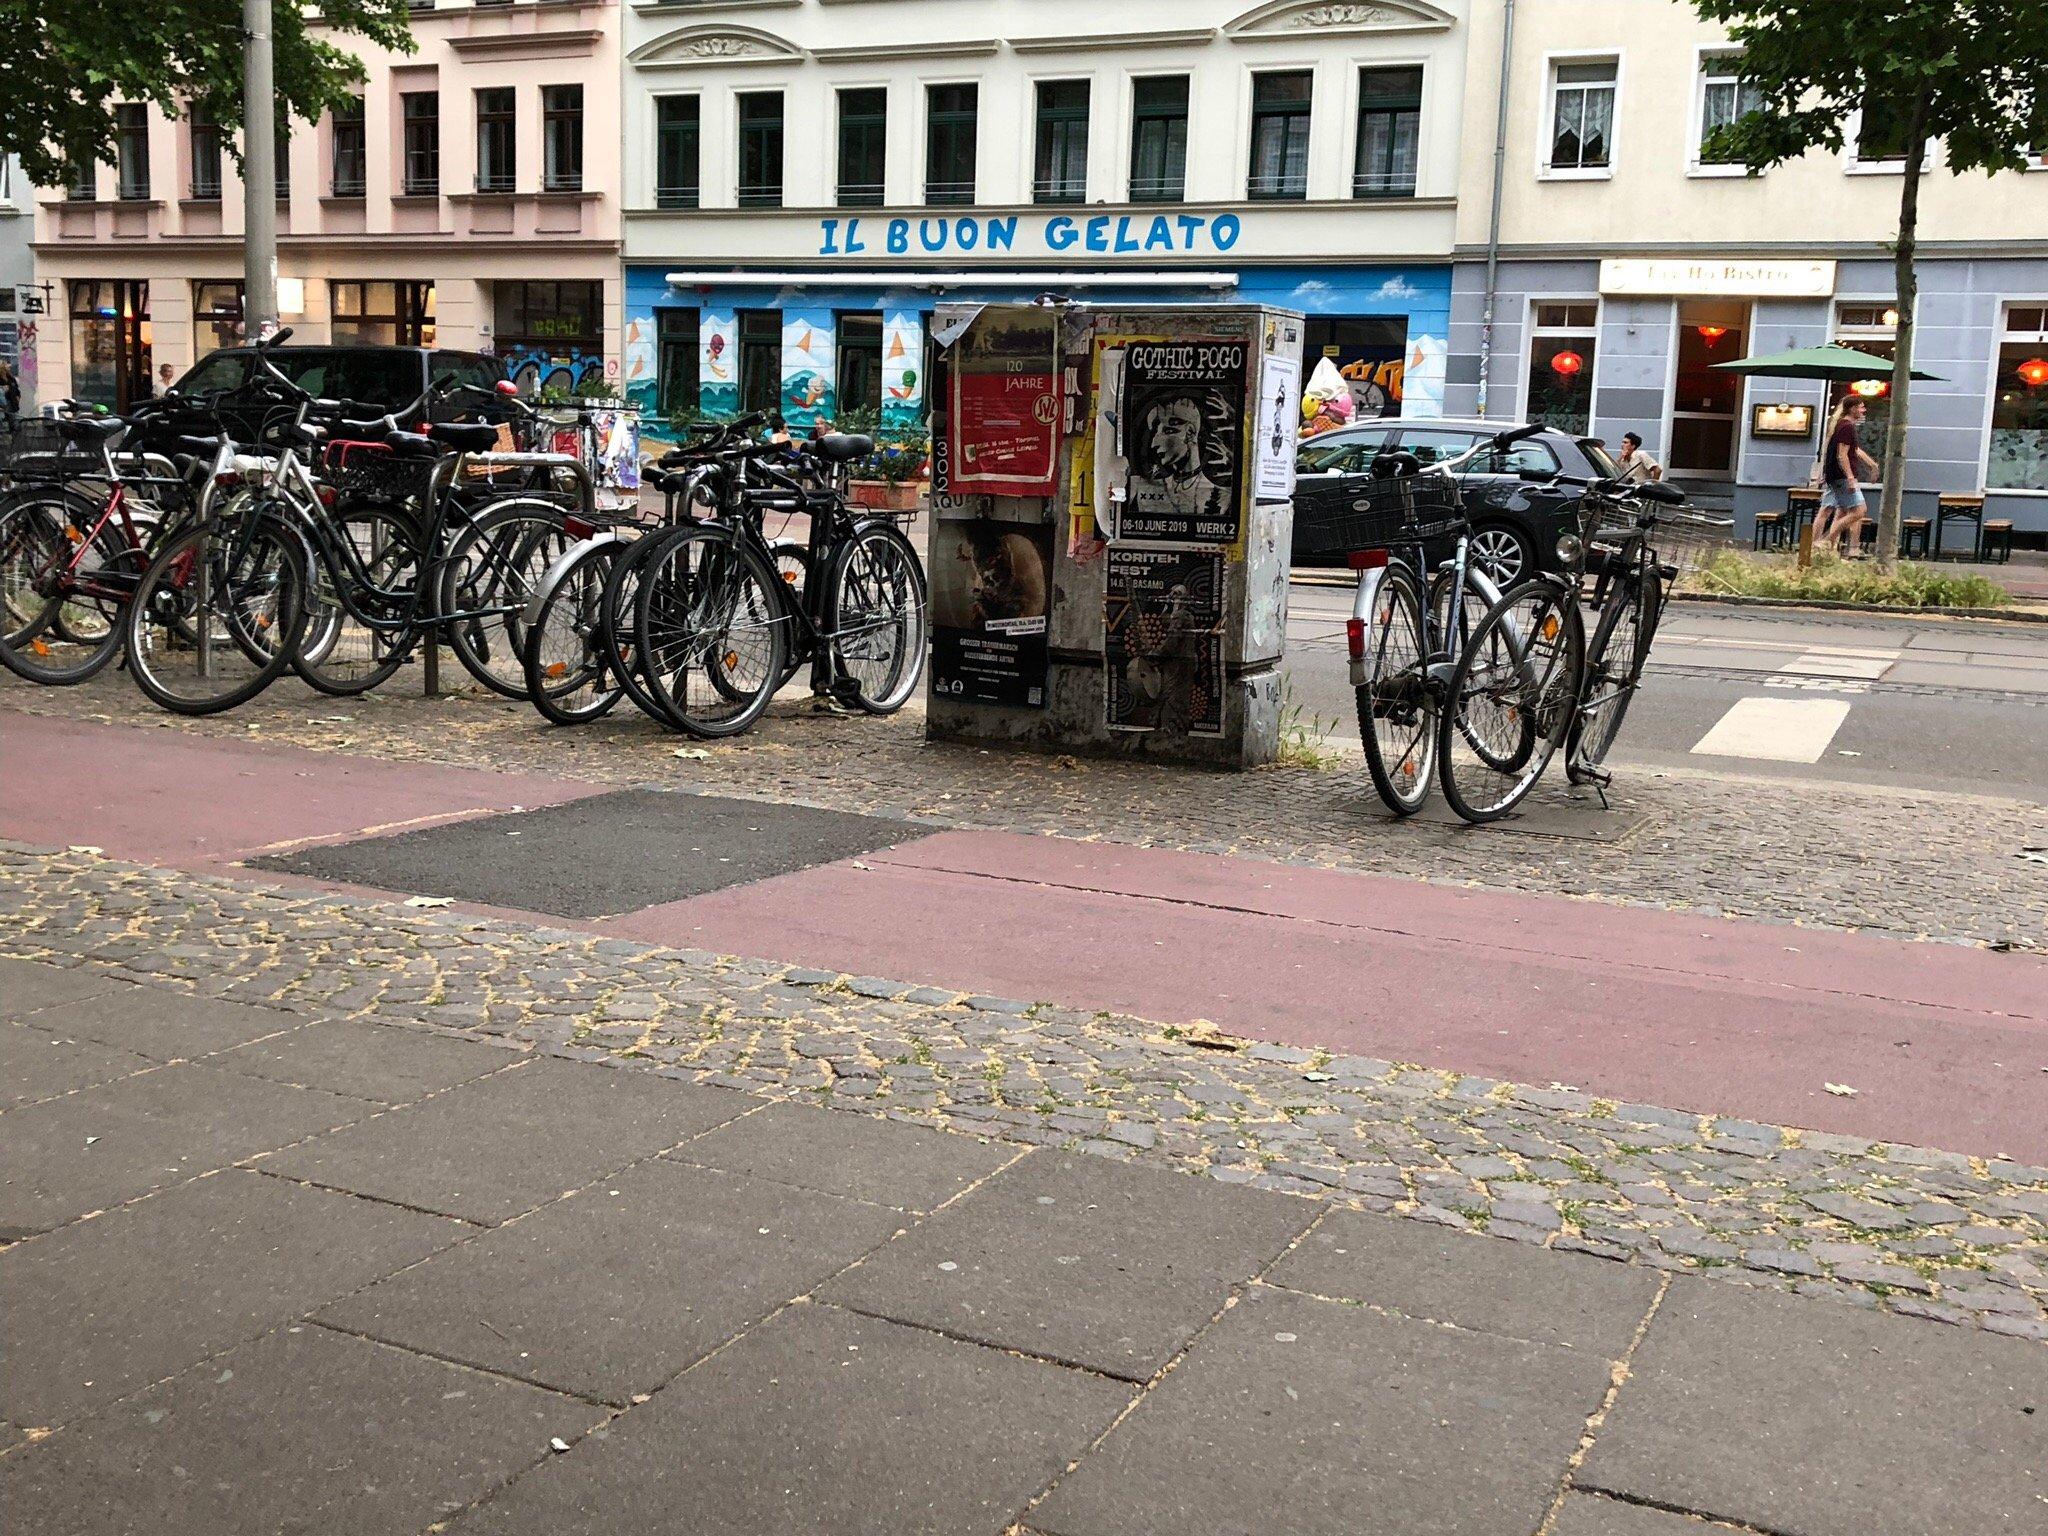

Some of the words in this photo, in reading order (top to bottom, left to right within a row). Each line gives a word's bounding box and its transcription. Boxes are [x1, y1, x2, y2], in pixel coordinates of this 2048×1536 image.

[819, 218, 865, 255] IL
[886, 216, 1019, 254] BUON
[1045, 214, 1240, 254] GELATO
[1131, 346, 1194, 370] GOTHIC
[1197, 346, 1242, 369] POGO
[1006, 360, 1023, 372] 120
[1145, 369, 1226, 380] FESTIVAL
[1004, 377, 1044, 393] JAHRE
[1122, 519, 1144, 531] 06-10
[1144, 520, 1167, 532] JUNE
[1168, 521, 1188, 533] 2019
[1195, 522, 1228, 535] WERK
[1228, 523, 1236, 535] 2
[1109, 565, 1152, 576] FEST
[1132, 578, 1164, 590] BASAMO
